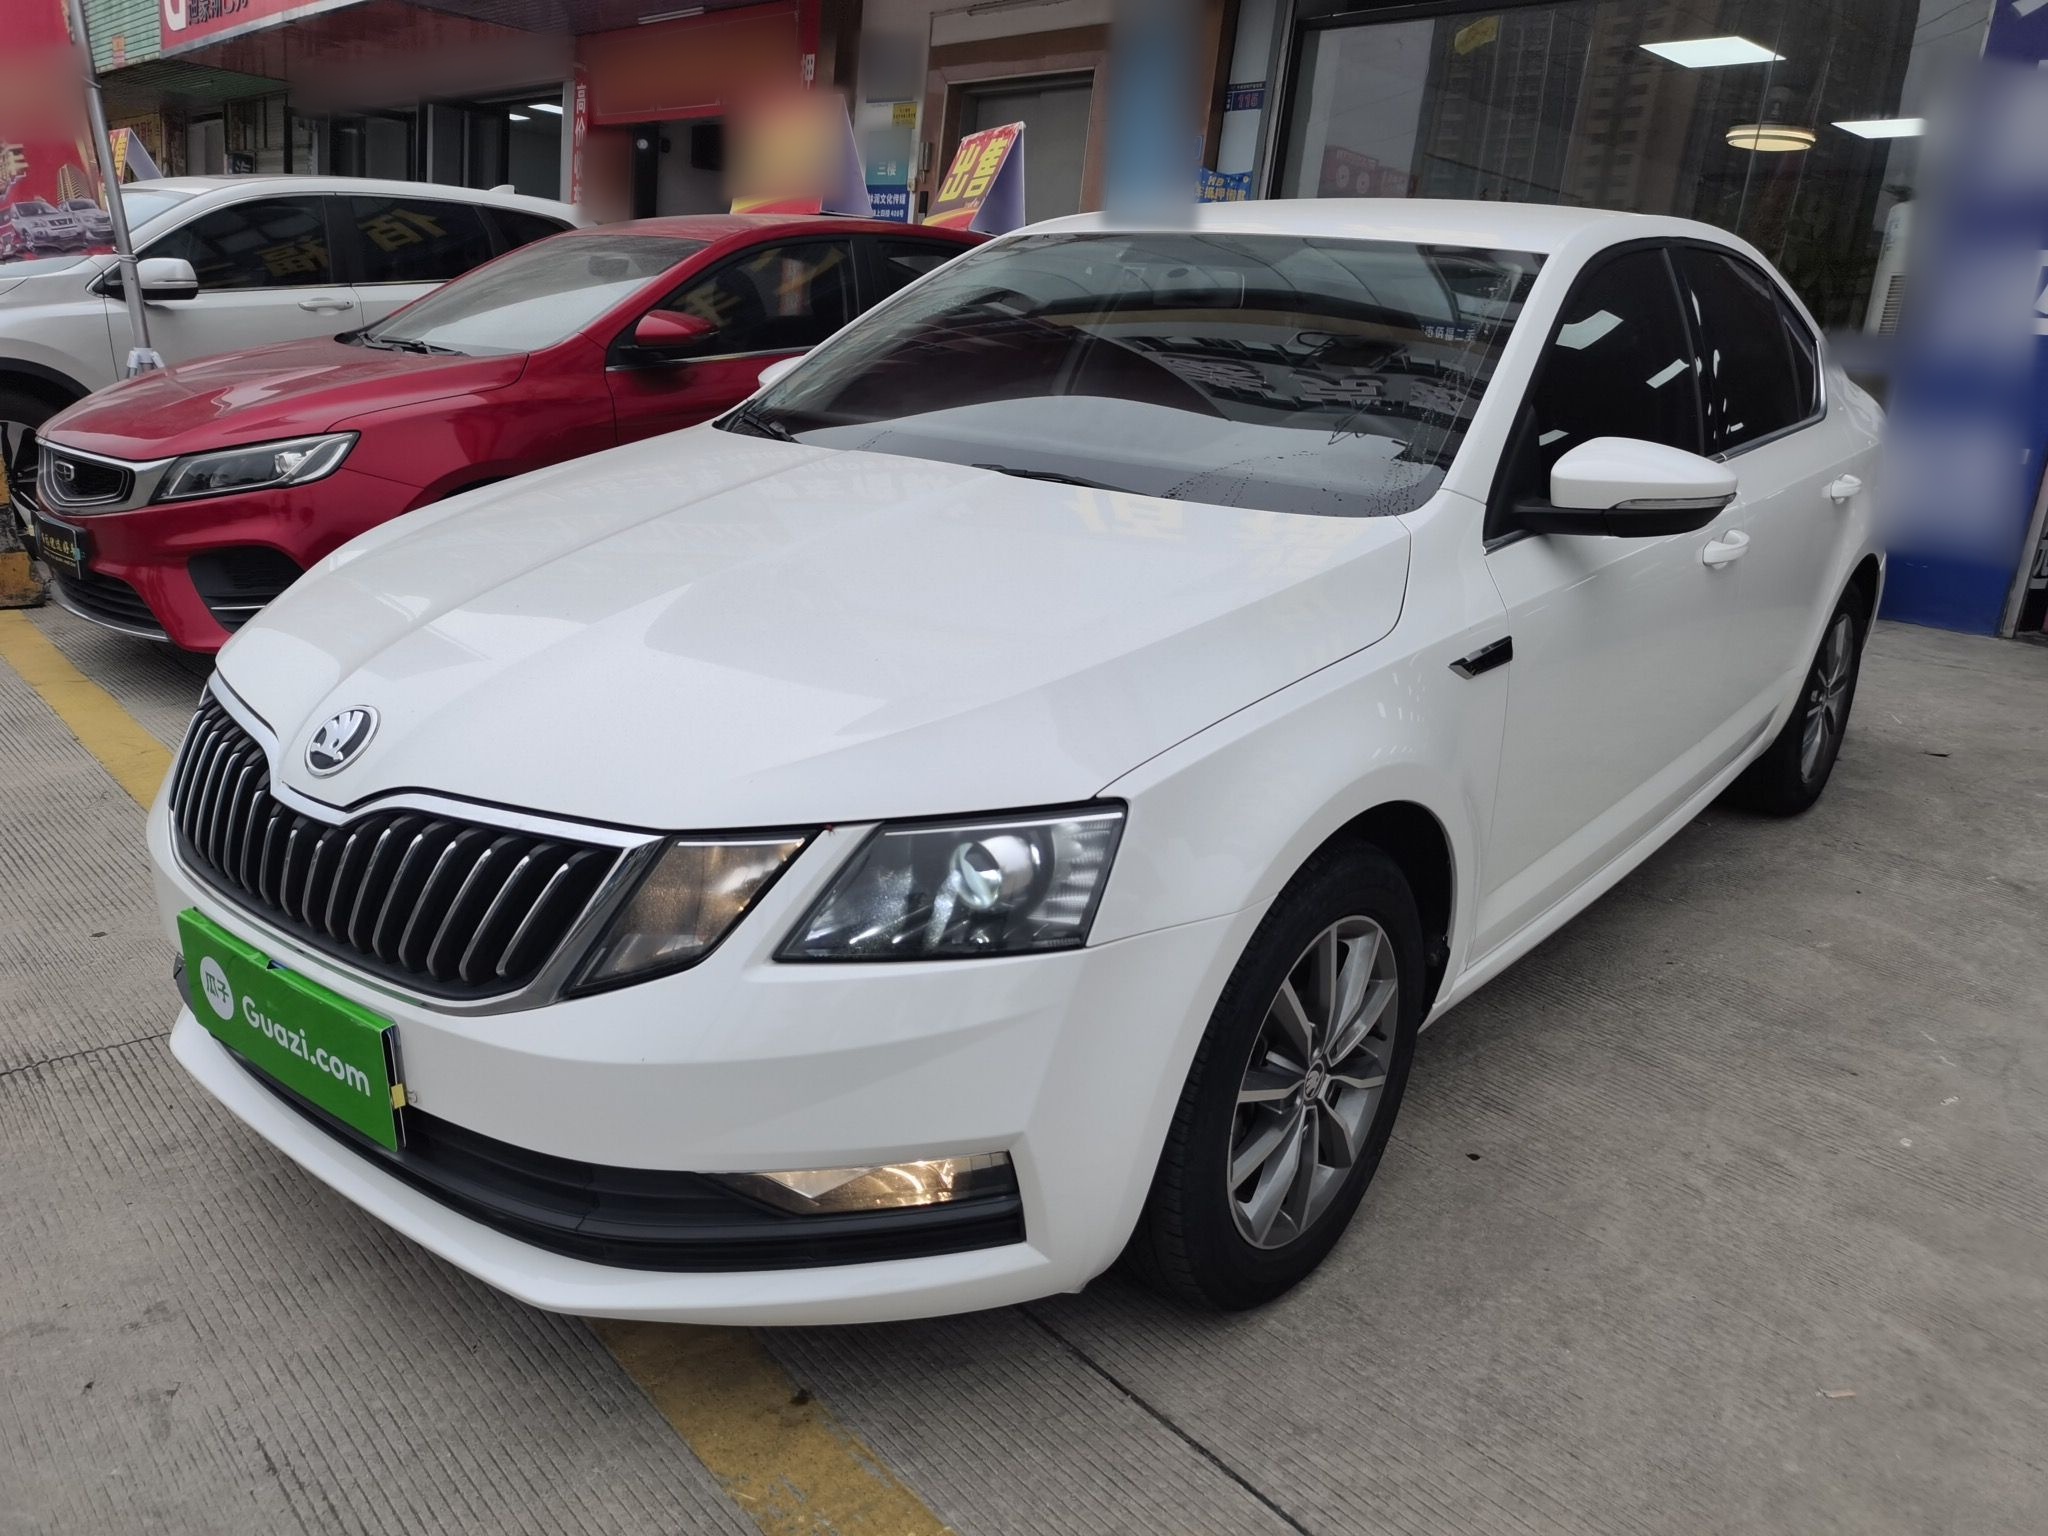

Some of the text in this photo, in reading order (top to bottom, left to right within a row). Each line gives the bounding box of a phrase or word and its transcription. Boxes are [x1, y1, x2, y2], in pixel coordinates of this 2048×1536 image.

[938, 137, 1009, 202] 出售
[205, 971, 230, 1004] 瓜子
[242, 995, 371, 1097] Guazi.com
